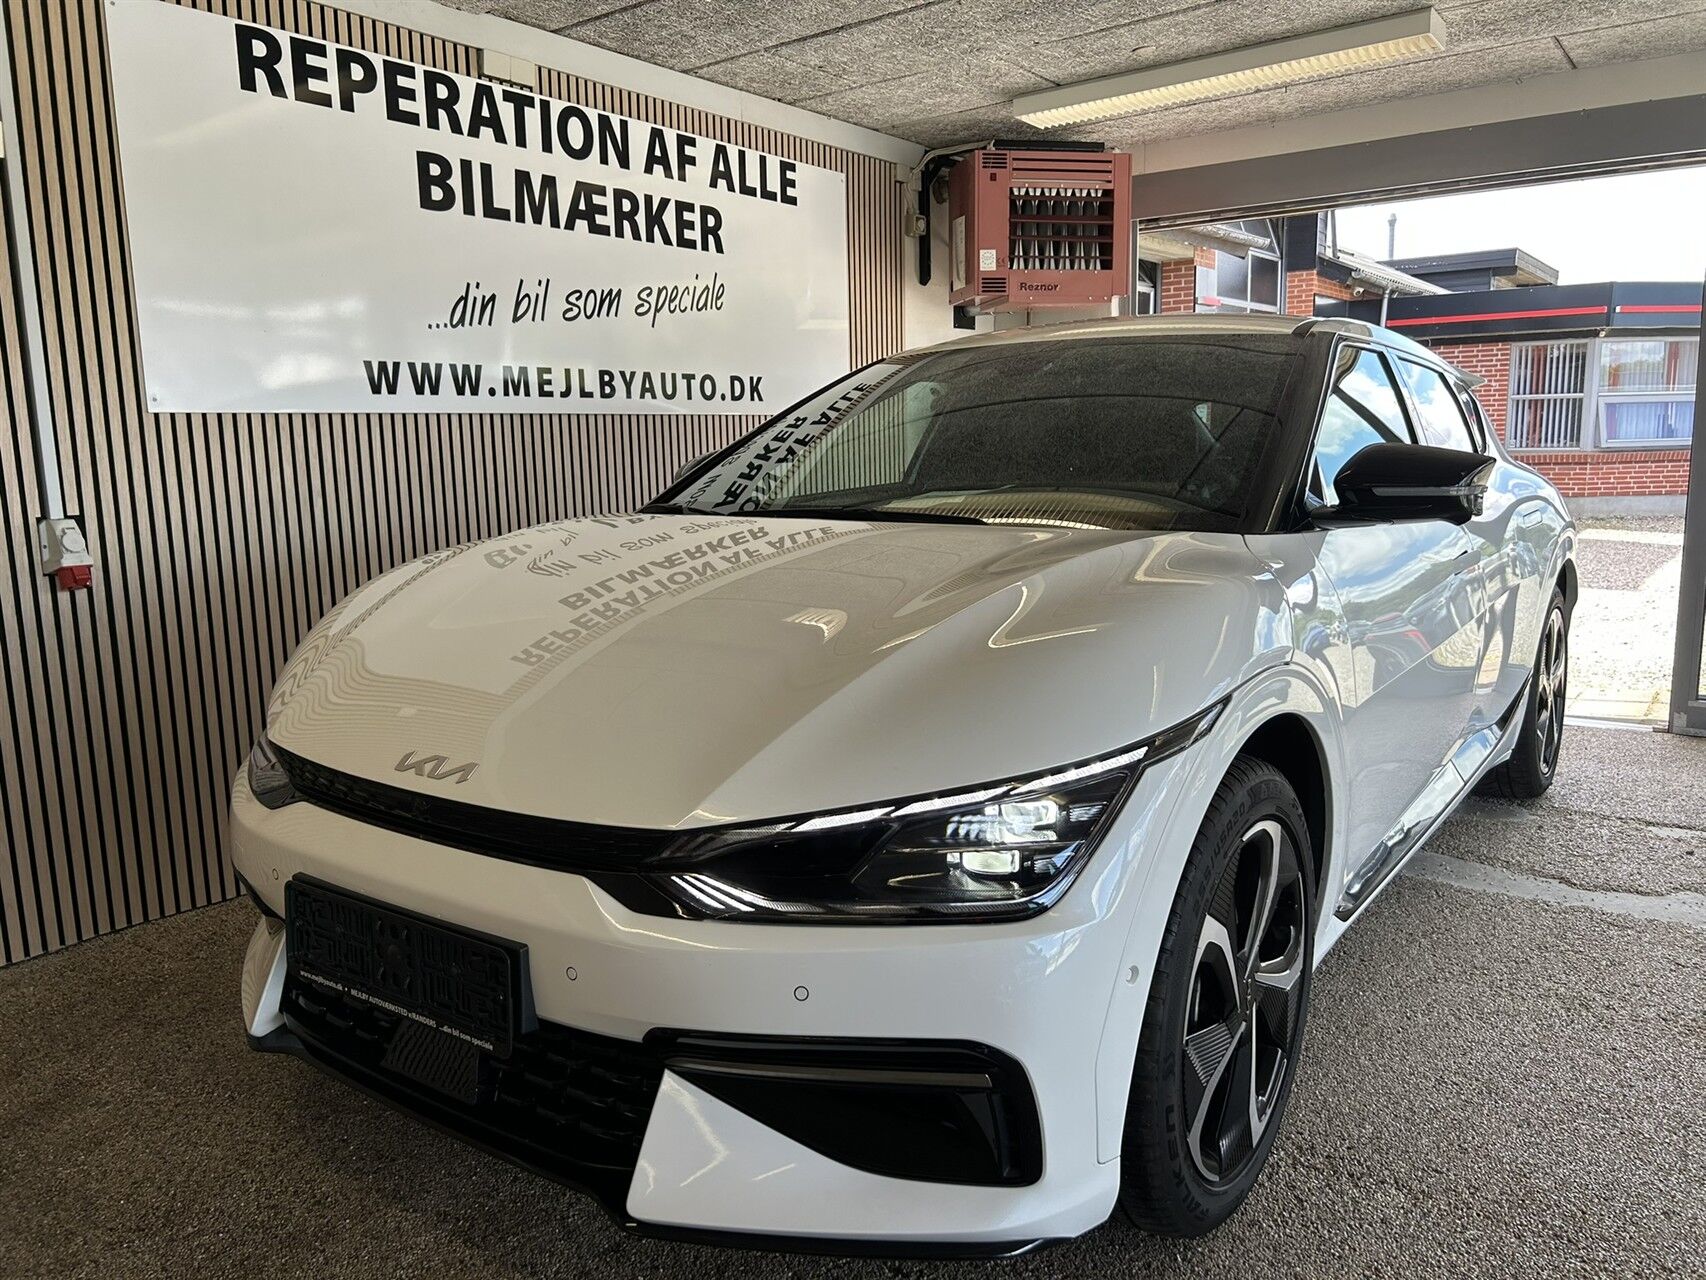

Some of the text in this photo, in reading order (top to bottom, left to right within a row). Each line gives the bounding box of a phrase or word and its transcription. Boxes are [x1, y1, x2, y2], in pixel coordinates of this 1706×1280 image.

[235, 23, 798, 206] REPERATION AF ALLE
[415, 150, 725, 255] BILMÆRKER
[512, 278, 551, 324] bil
[562, 287, 622, 322] som
[635, 272, 725, 328] speciale
[1019, 282, 1059, 292] Reznor
[363, 360, 764, 402] WWW.MEJLBYAUTO.DK
